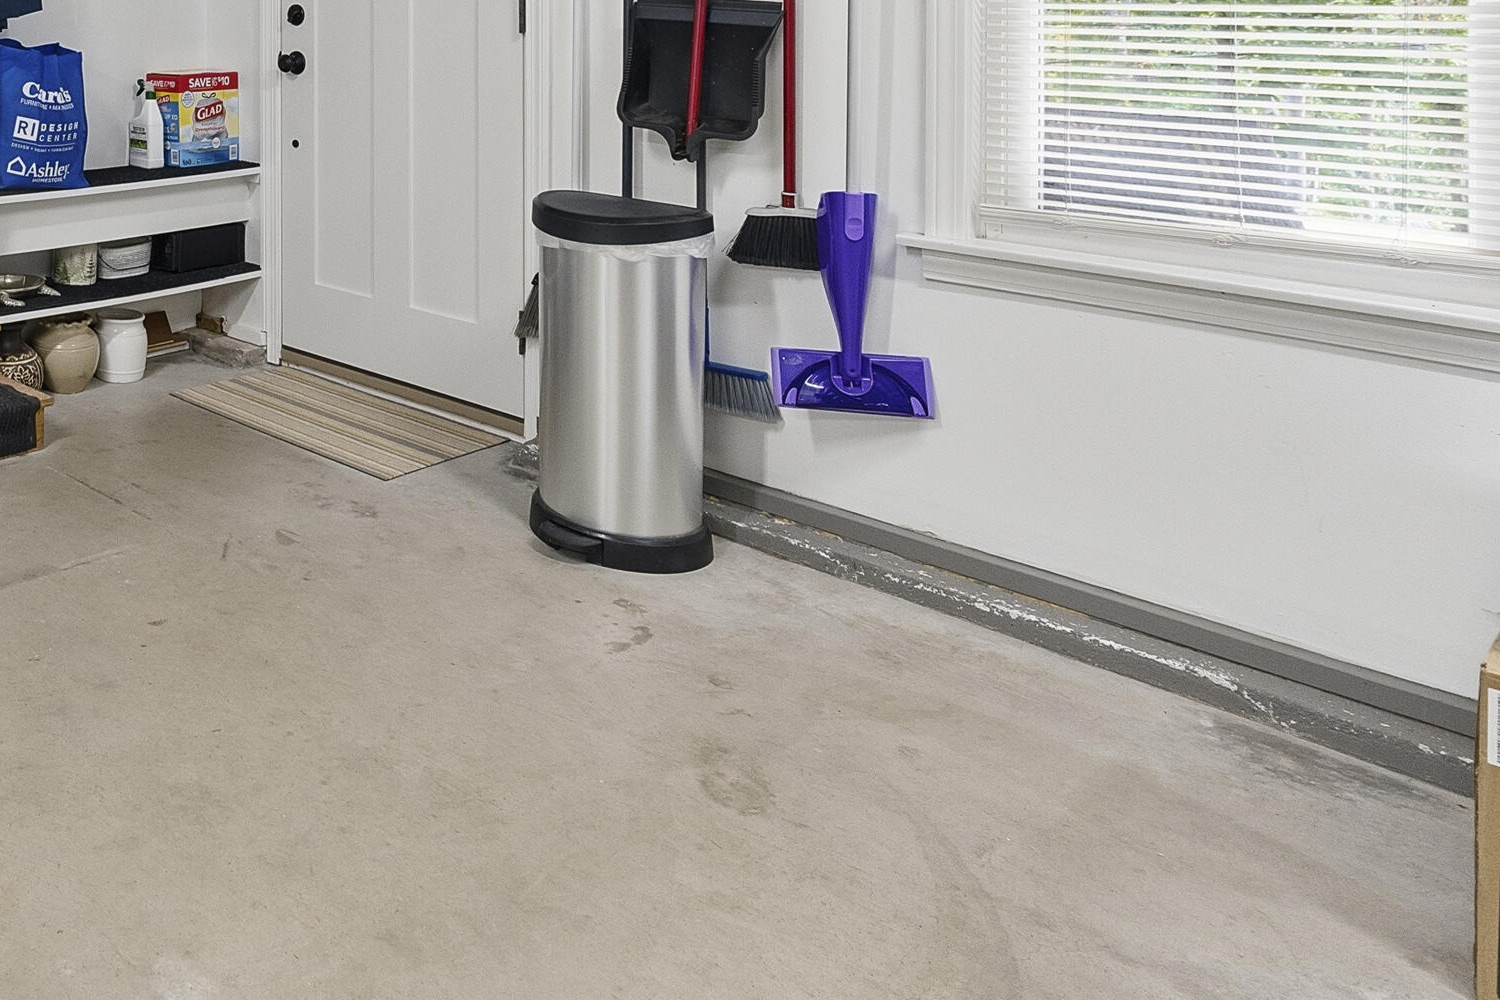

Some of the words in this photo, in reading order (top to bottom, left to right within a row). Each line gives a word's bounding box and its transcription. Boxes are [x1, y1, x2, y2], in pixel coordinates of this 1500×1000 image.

[189, 78, 212, 88] SAVE
[197, 104, 222, 120] GLAD
[17, 120, 36, 137] RI
[41, 121, 79, 132] DESIGN
[39, 132, 77, 142] CENTER
